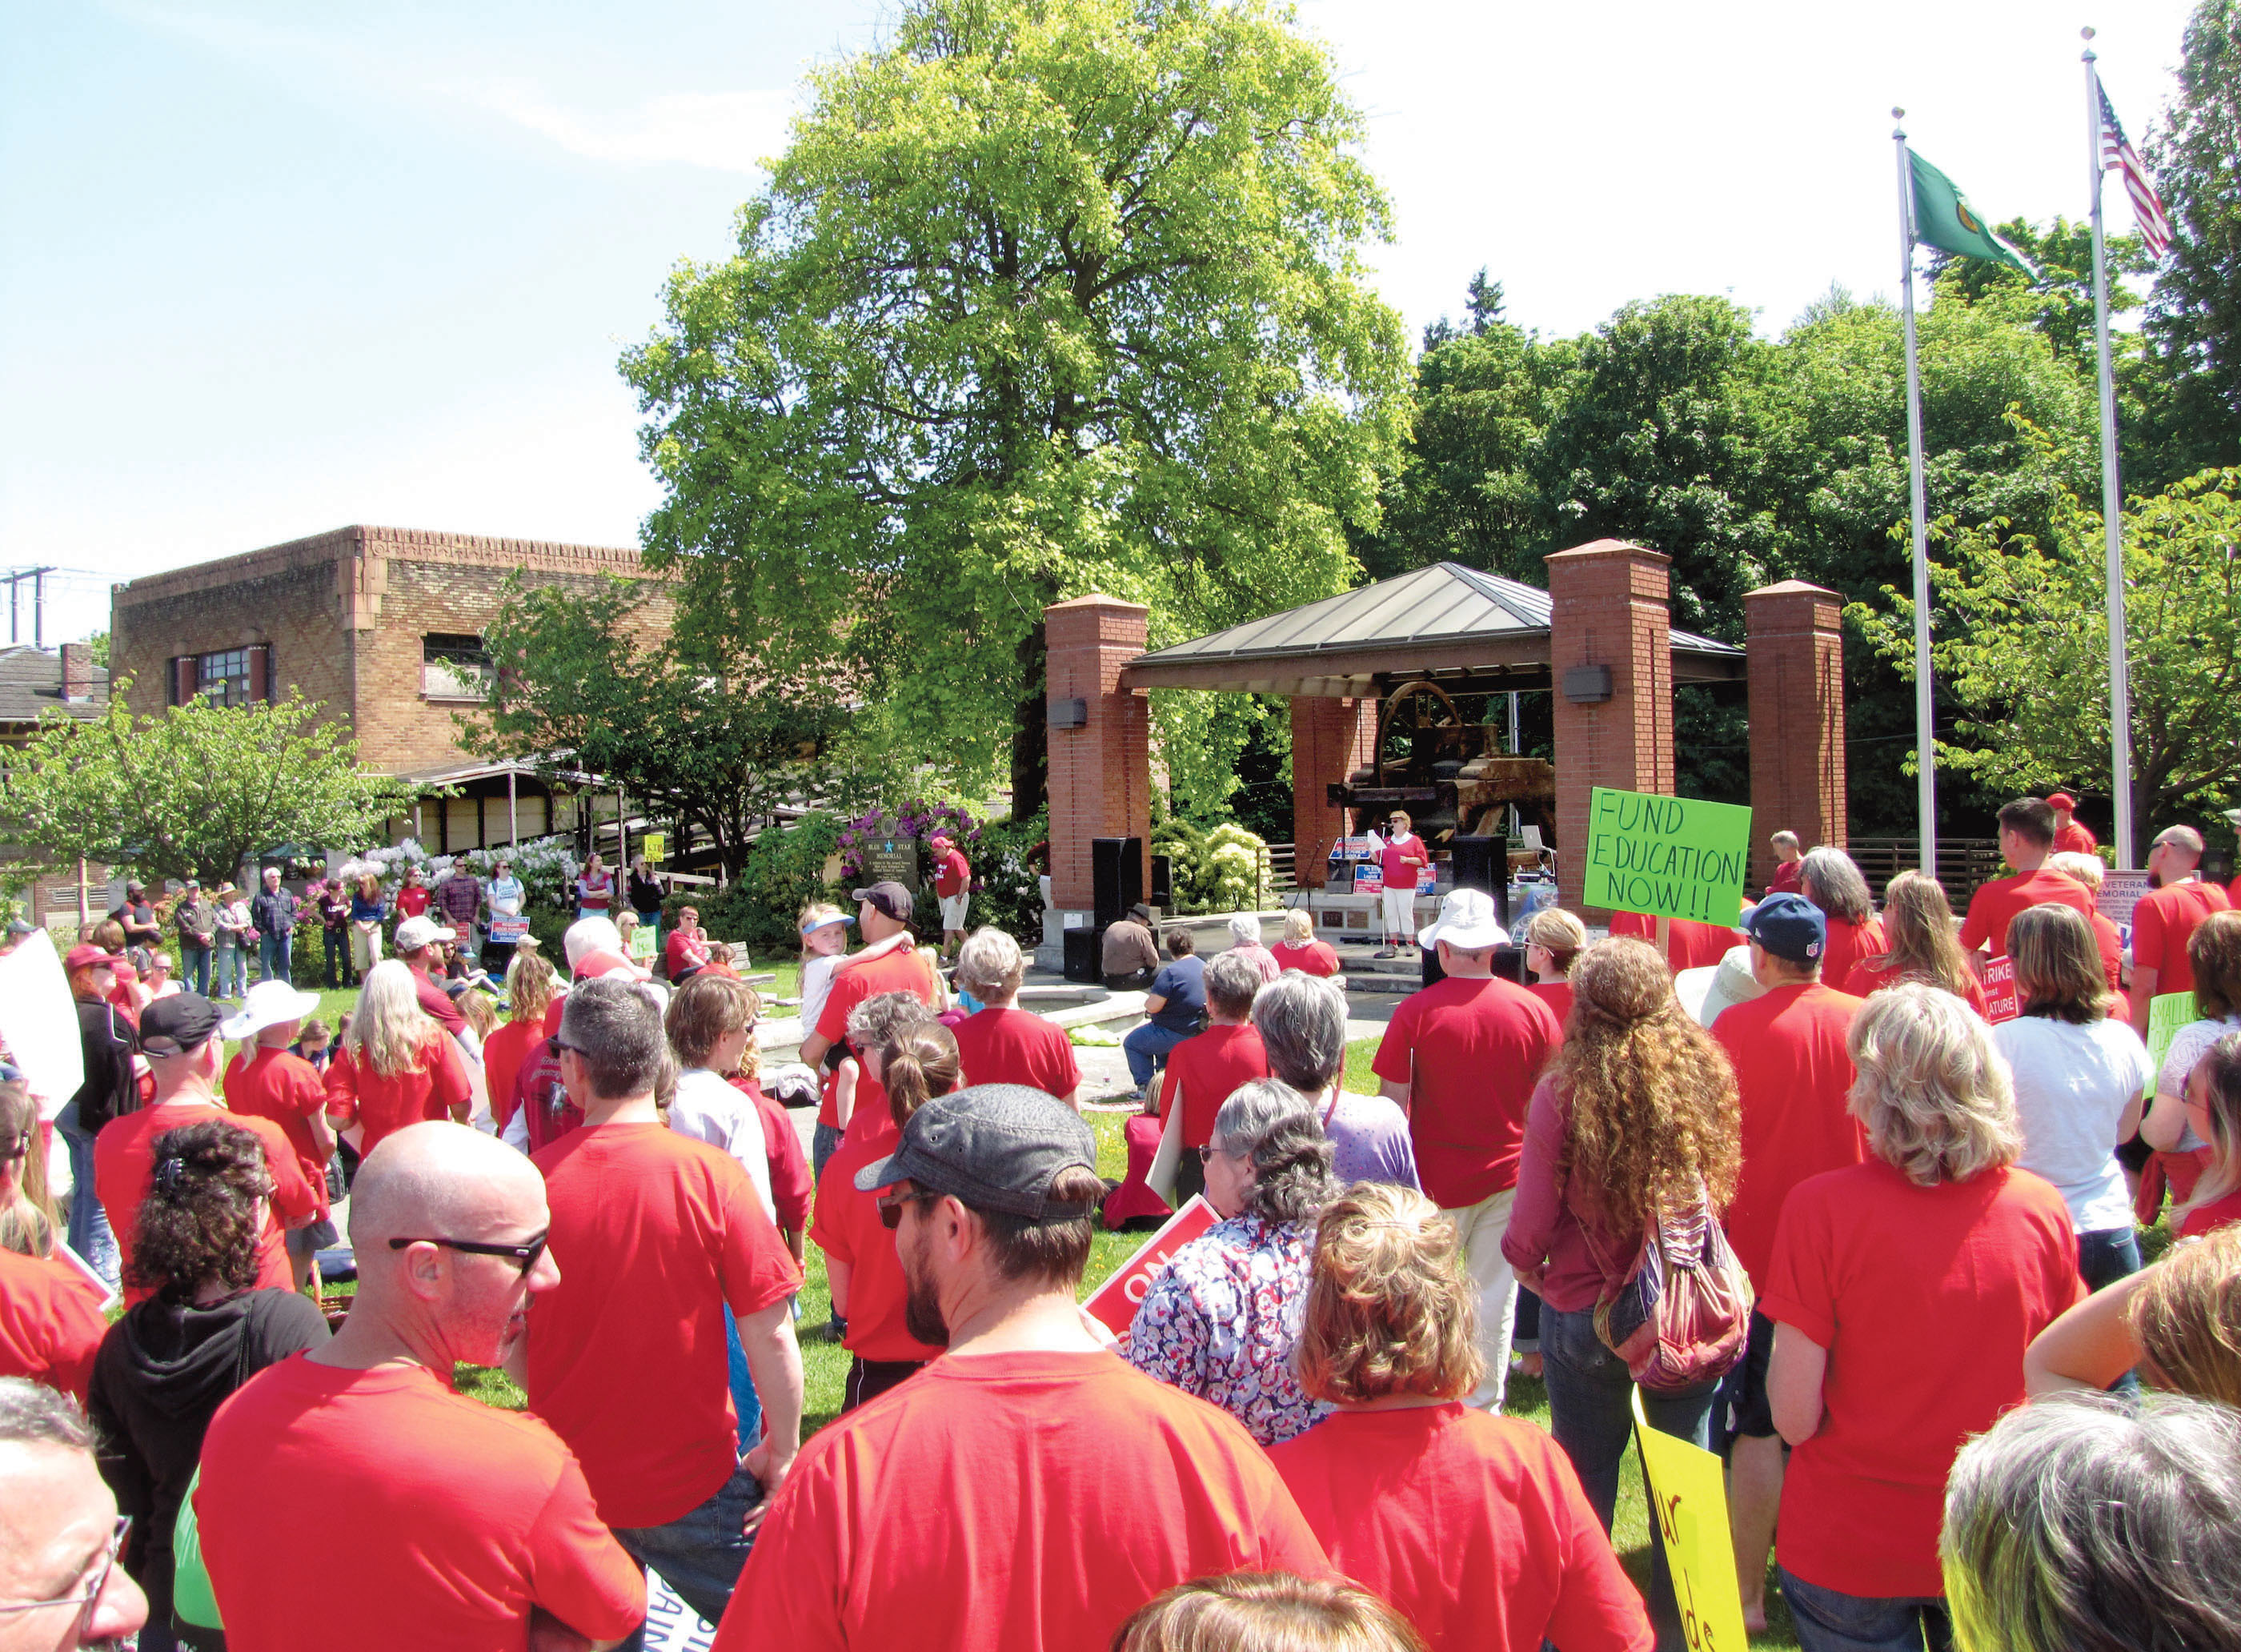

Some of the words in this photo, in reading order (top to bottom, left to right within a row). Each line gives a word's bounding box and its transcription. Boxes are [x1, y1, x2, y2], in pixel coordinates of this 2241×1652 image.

[1599, 792, 1684, 834] FUND
[1593, 833, 1741, 885] EDUCATION
[1607, 872, 1710, 920] NOW!!
[1980, 963, 2010, 985] TRIKE
